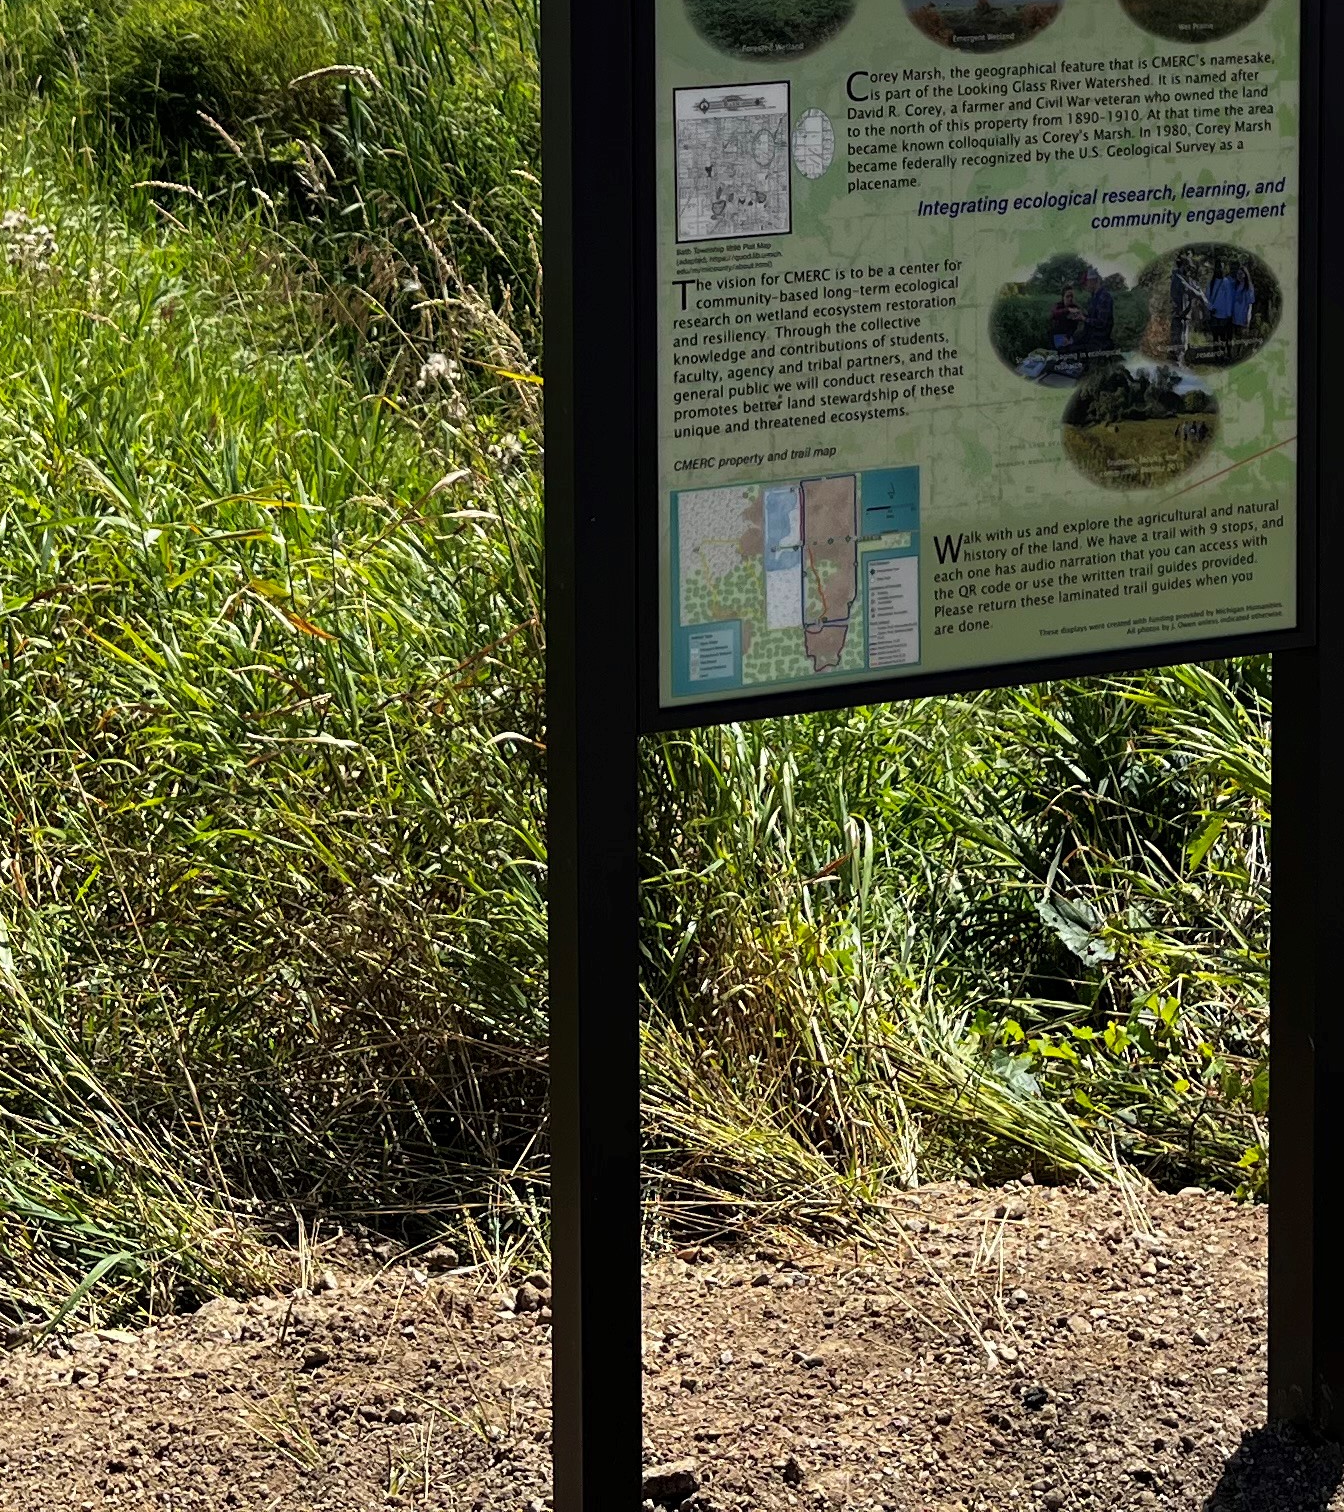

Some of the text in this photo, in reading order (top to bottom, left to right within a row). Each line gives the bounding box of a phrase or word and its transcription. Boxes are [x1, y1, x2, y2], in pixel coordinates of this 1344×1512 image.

[917, 173, 1286, 220] Integrating ecological research, learning, and
[1090, 198, 1286, 230] community engagement
[672, 447, 837, 472] CMERC property and trail map
